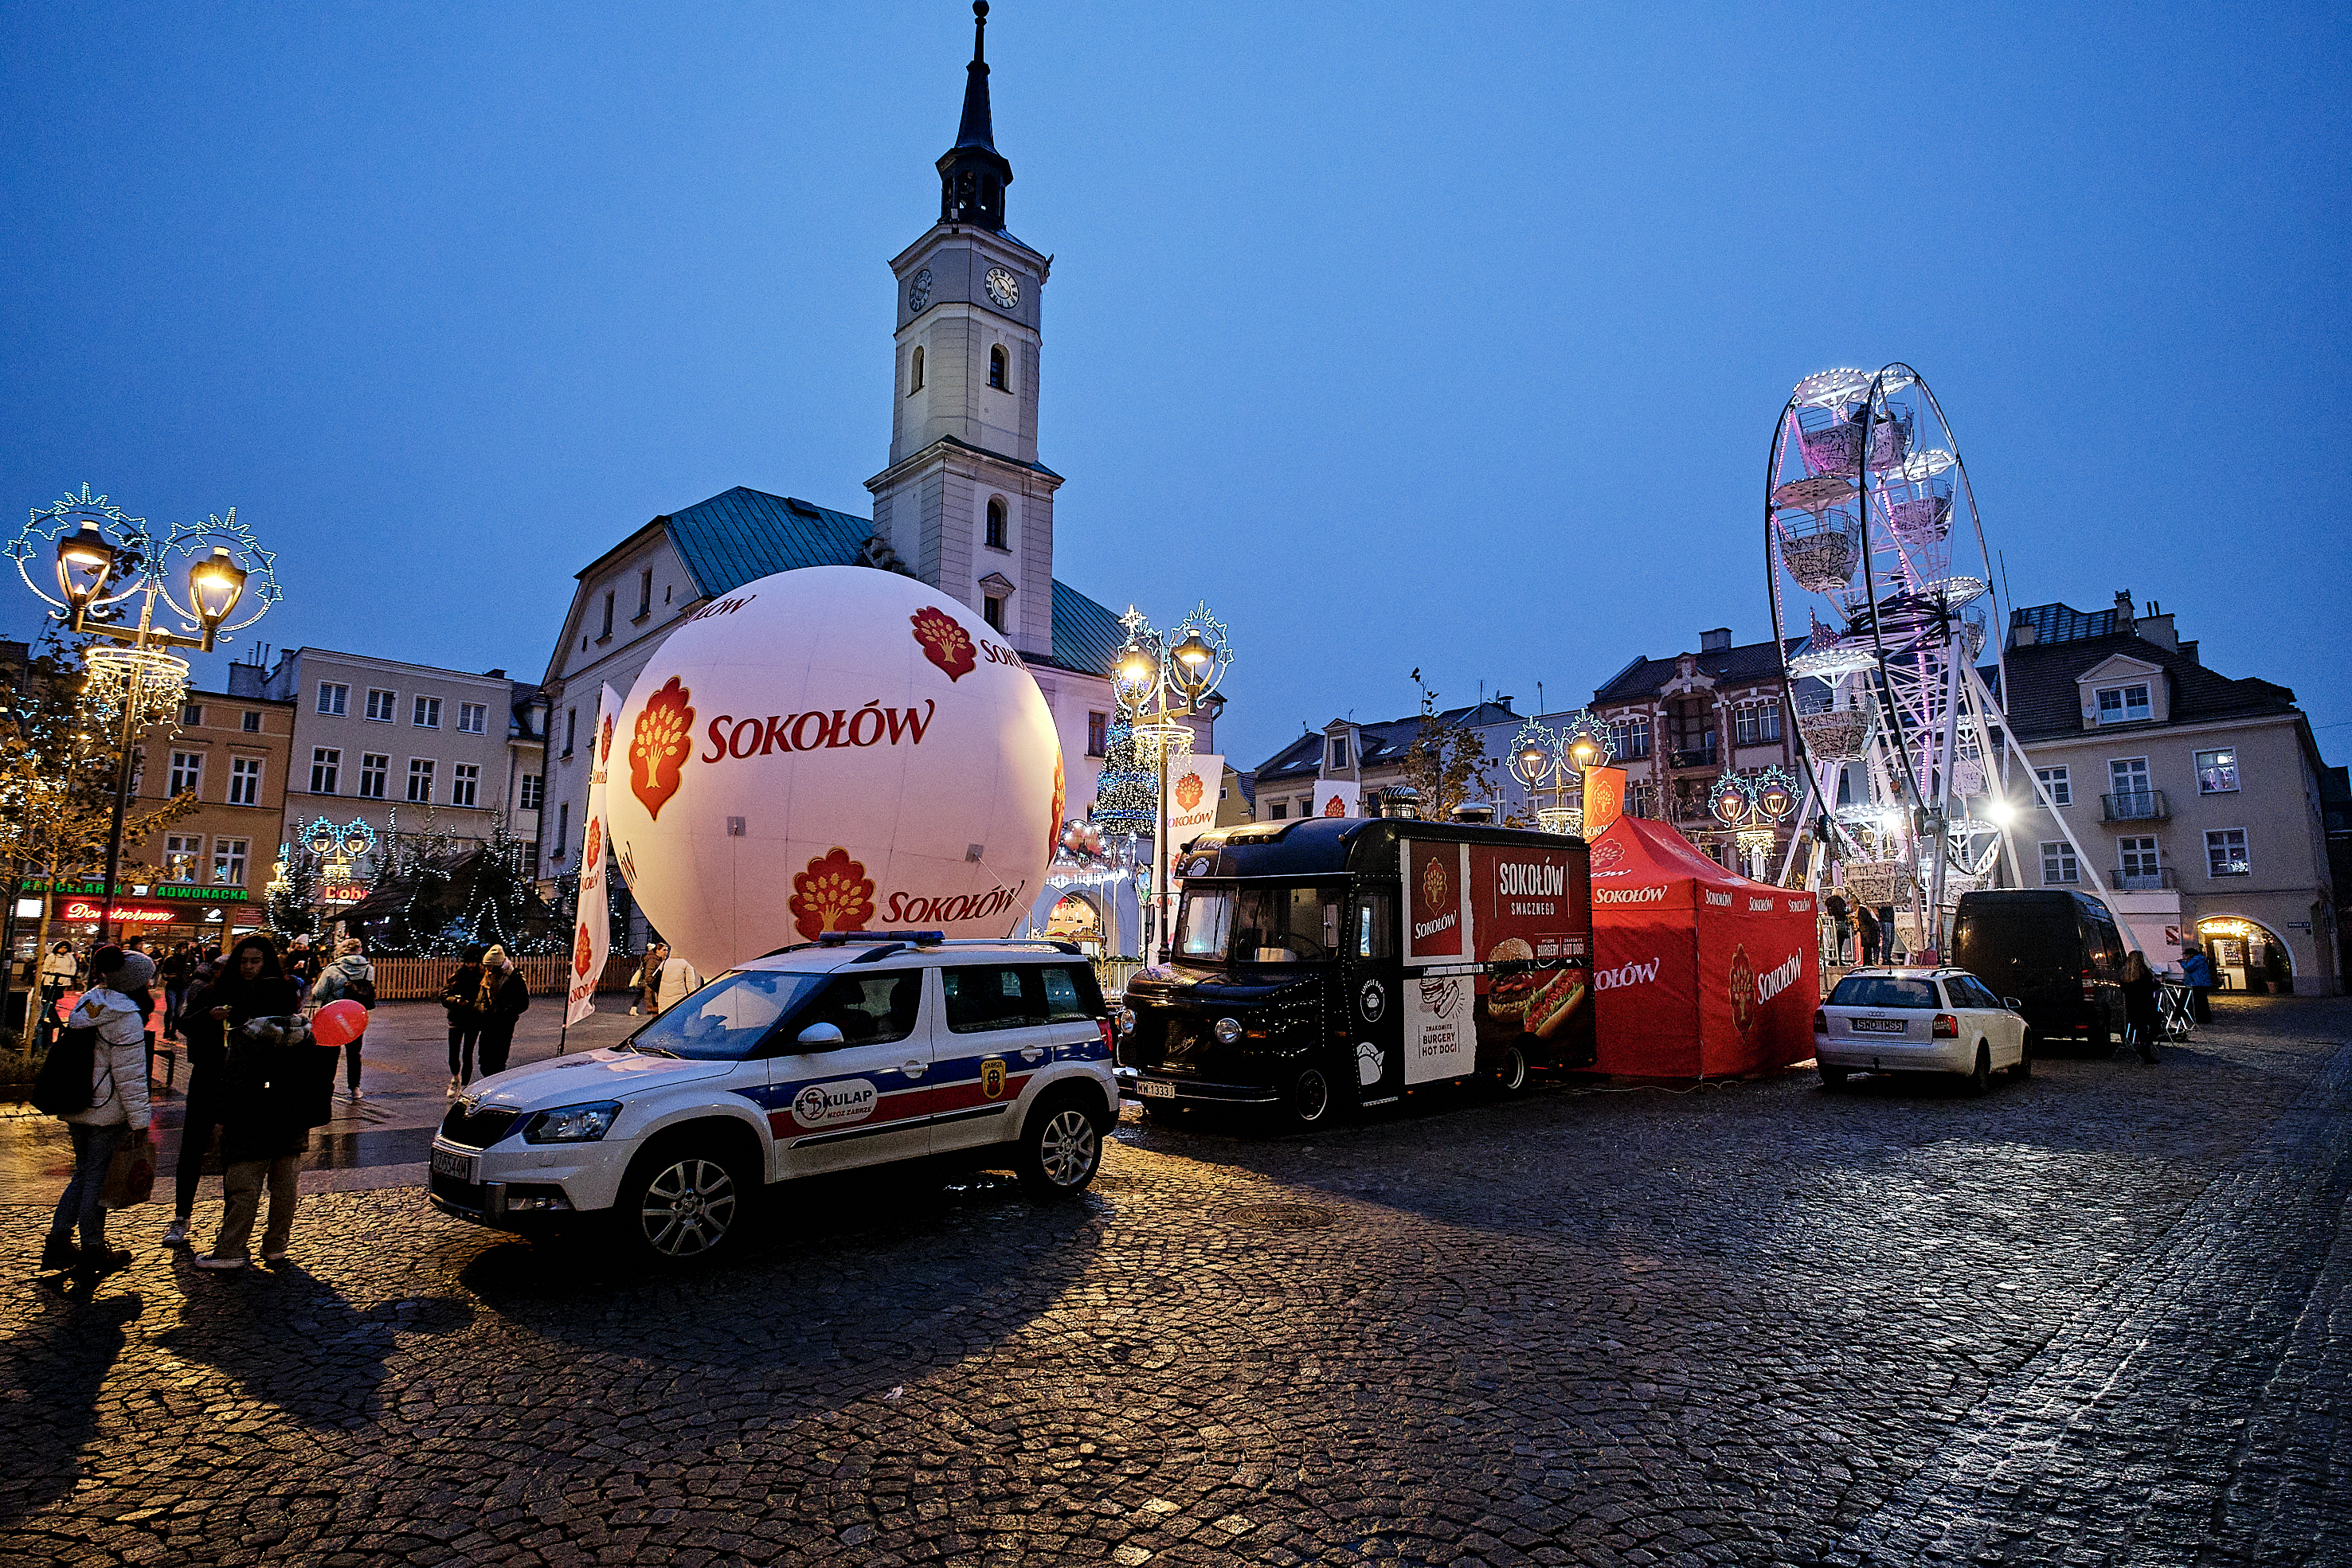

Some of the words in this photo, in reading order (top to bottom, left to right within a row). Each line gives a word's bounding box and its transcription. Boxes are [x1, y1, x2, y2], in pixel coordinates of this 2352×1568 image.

[980, 639, 1031, 673] SOKO
[702, 698, 935, 764] SOKOŁÓW
[1166, 809, 1214, 828] OKOŁÓW
[1499, 855, 1564, 896] SOKOŁÓW
[157, 886, 248, 901] ADWOKACKA
[882, 879, 1025, 924] SOKOŁÓW
[1595, 885, 1668, 904] SOKOŁÓW
[1705, 889, 1733, 907] SOKOŁÓW
[1511, 902, 1555, 915] SMACZNEGO
[1748, 896, 1775, 912] SOKOŁÓW
[1787, 897, 1812, 913] SOKOŁÓW
[1415, 909, 1458, 940] SOKOŁÓW
[1537, 944, 1559, 956] BURGERY
[1563, 944, 1572, 956] HOT
[1573, 943, 1584, 955] DOGI
[1757, 947, 1802, 1005] SOKOŁÓW
[1426, 1023, 1453, 1032] ZNAKOMITE
[1423, 1031, 1456, 1045] BURGERY
[1423, 1046, 1438, 1057] HOT
[1439, 1042, 1457, 1054] DOGI
[1151, 1085, 1173, 1097] 1333J
[827, 1109, 846, 1119] NZOZ
[846, 1106, 872, 1116] ZABRZE
